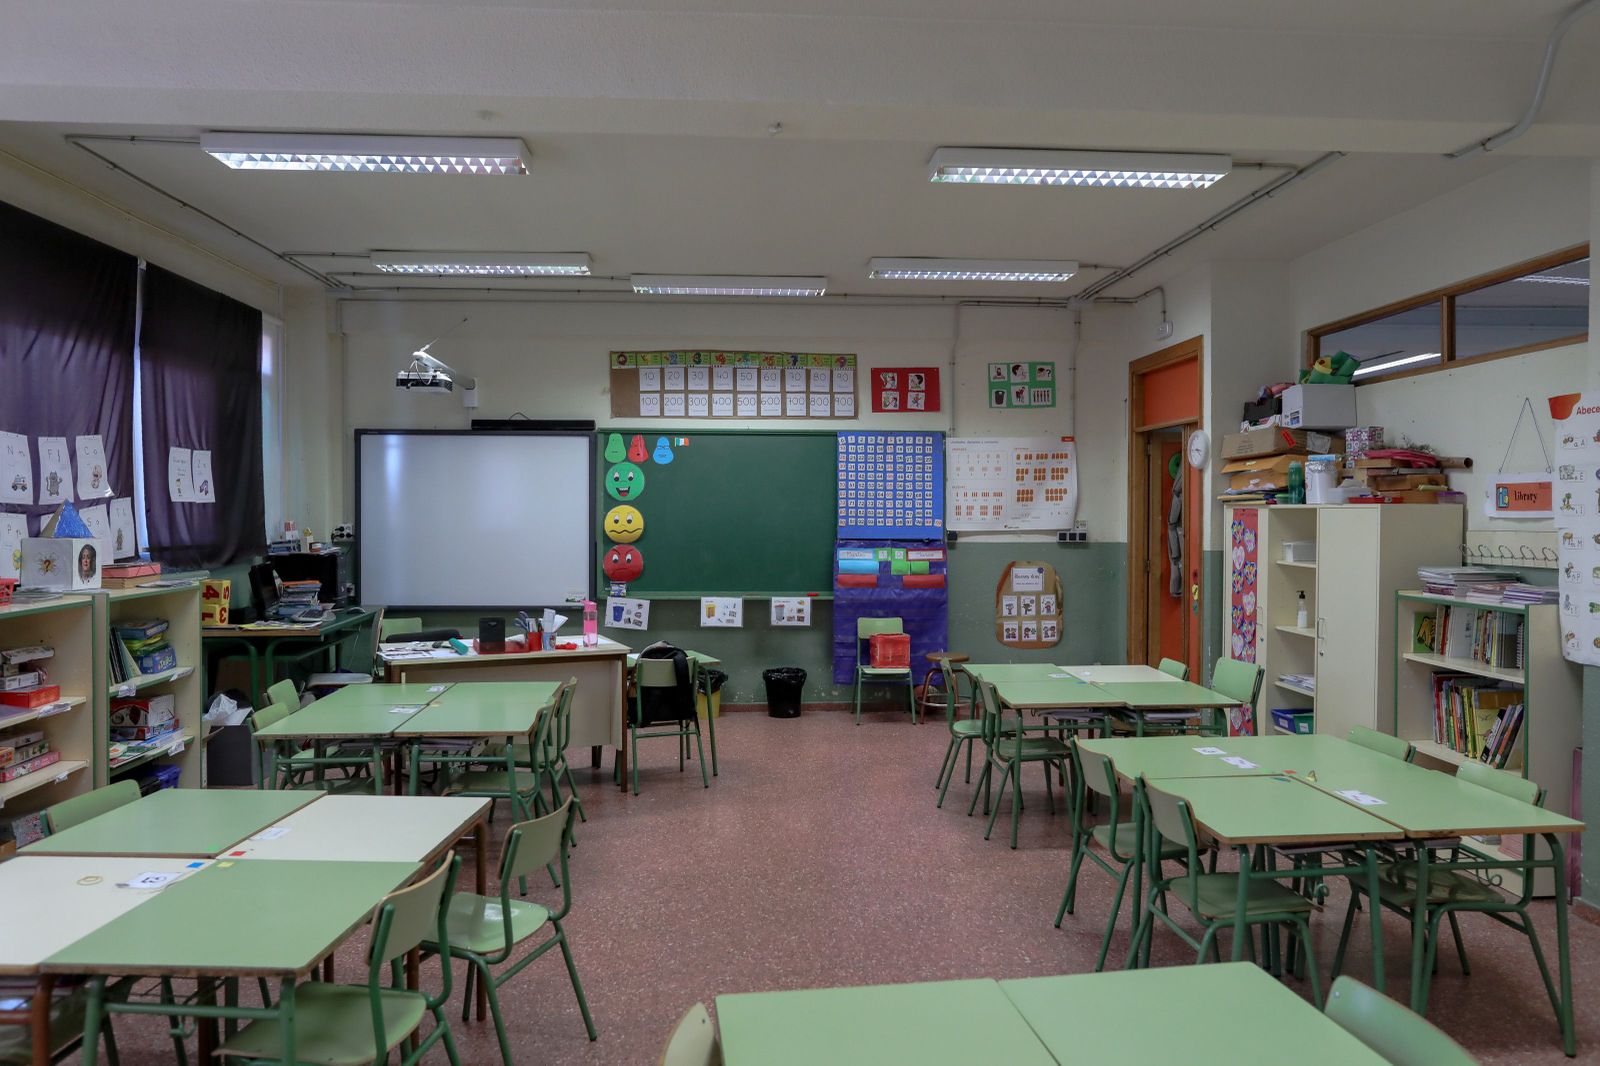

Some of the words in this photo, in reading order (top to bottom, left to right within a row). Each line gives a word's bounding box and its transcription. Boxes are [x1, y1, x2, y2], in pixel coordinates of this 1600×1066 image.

[644, 371, 655, 381] 10
[667, 371, 681, 380] 20
[691, 371, 704, 380] 30
[716, 371, 729, 380] 40
[740, 372, 753, 381] 50
[763, 372, 777, 382] 60
[641, 397, 658, 406] 100
[664, 397, 683, 407] 200
[688, 397, 707, 407] 300
[712, 397, 732, 407] 400
[737, 397, 756, 407] 500
[7, 446, 14, 456] N
[1514, 490, 1537, 504] Library
[202, 585, 220, 600] 4
